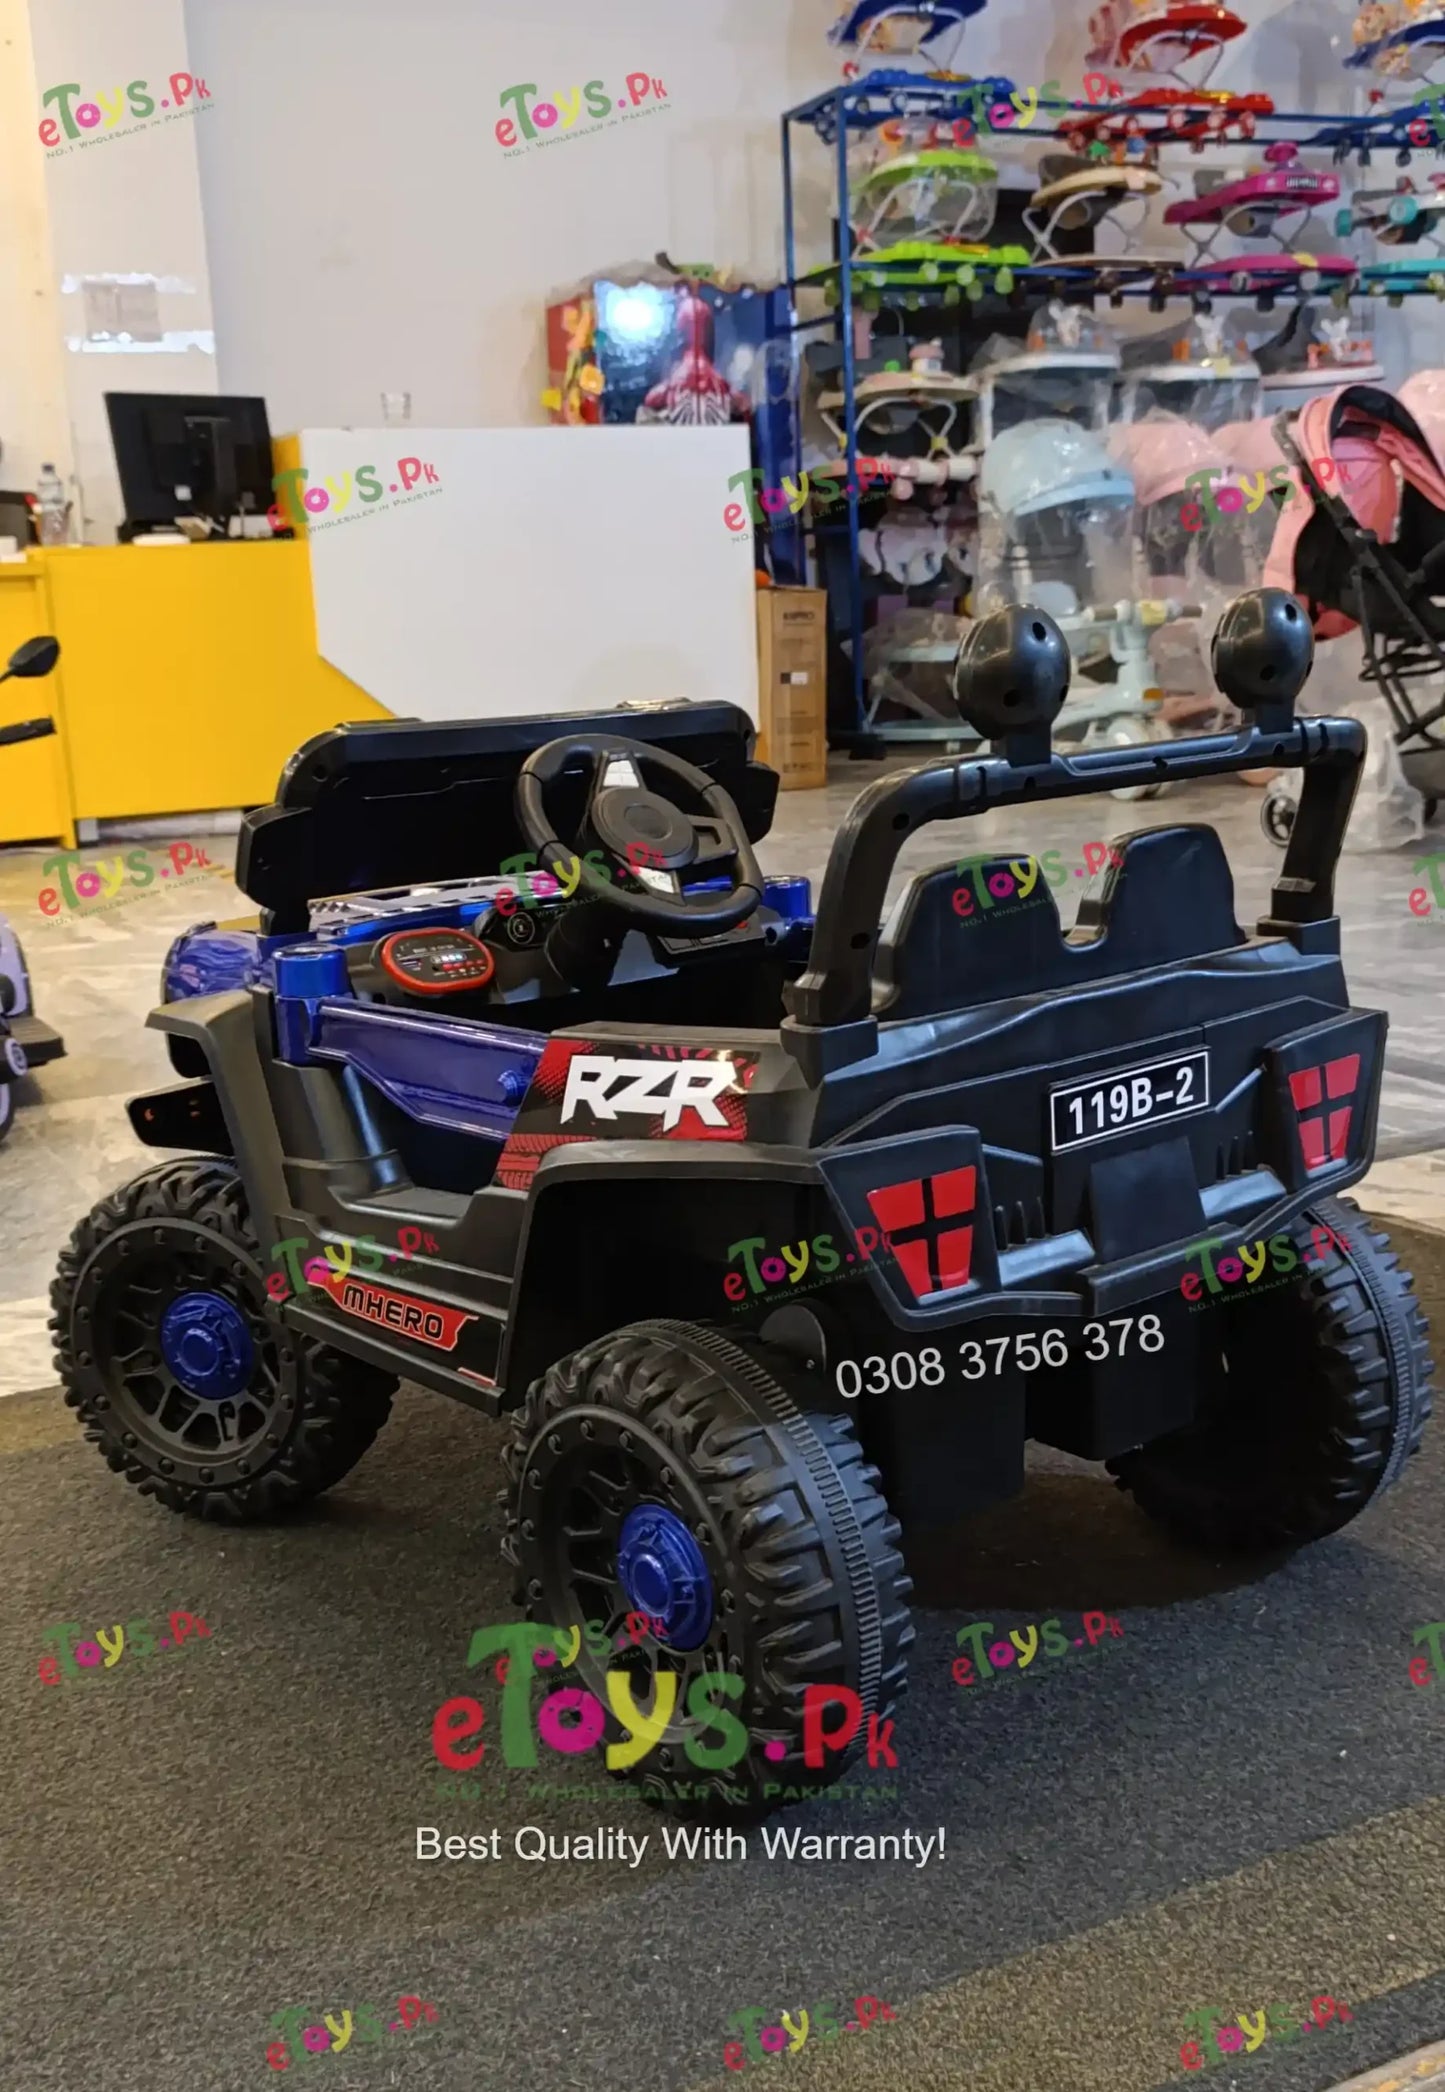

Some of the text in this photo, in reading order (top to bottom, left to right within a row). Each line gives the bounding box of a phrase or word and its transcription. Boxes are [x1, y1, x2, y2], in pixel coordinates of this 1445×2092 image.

[560, 1055, 737, 1132] RZR
[1069, 1066, 1194, 1134] 119B-2
[343, 1284, 444, 1340] MHERO
